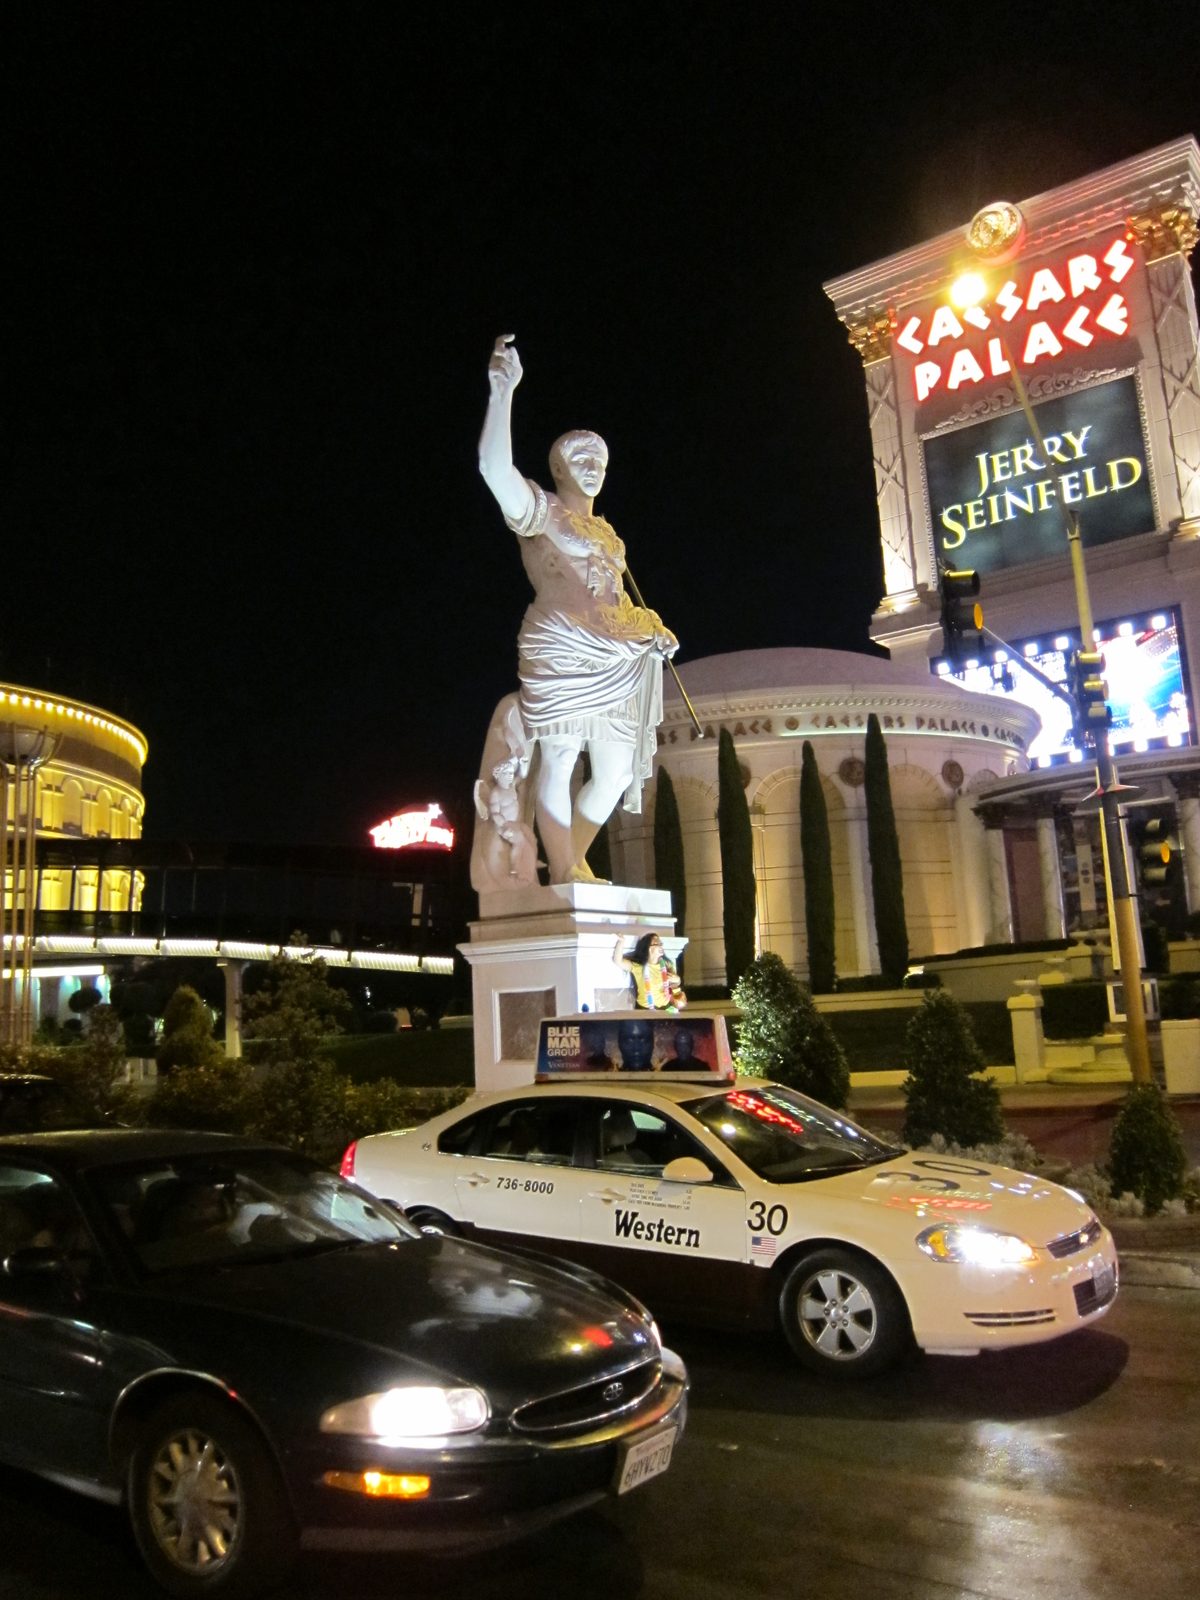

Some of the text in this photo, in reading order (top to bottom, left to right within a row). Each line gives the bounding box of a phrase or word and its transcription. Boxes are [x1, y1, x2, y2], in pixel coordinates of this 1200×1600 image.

[914, 293, 1128, 402] PALACE
[975, 425, 1093, 498] JERRY
[940, 457, 1143, 550] SEINFELD
[915, 716, 977, 734] PALACE
[547, 1026, 580, 1037] BLUE
[547, 1036, 580, 1049] MAN
[547, 1048, 581, 1057] GROUP
[496, 1176, 555, 1195] 736-8000
[614, 1208, 701, 1249] Western
[747, 1200, 789, 1236] 30
